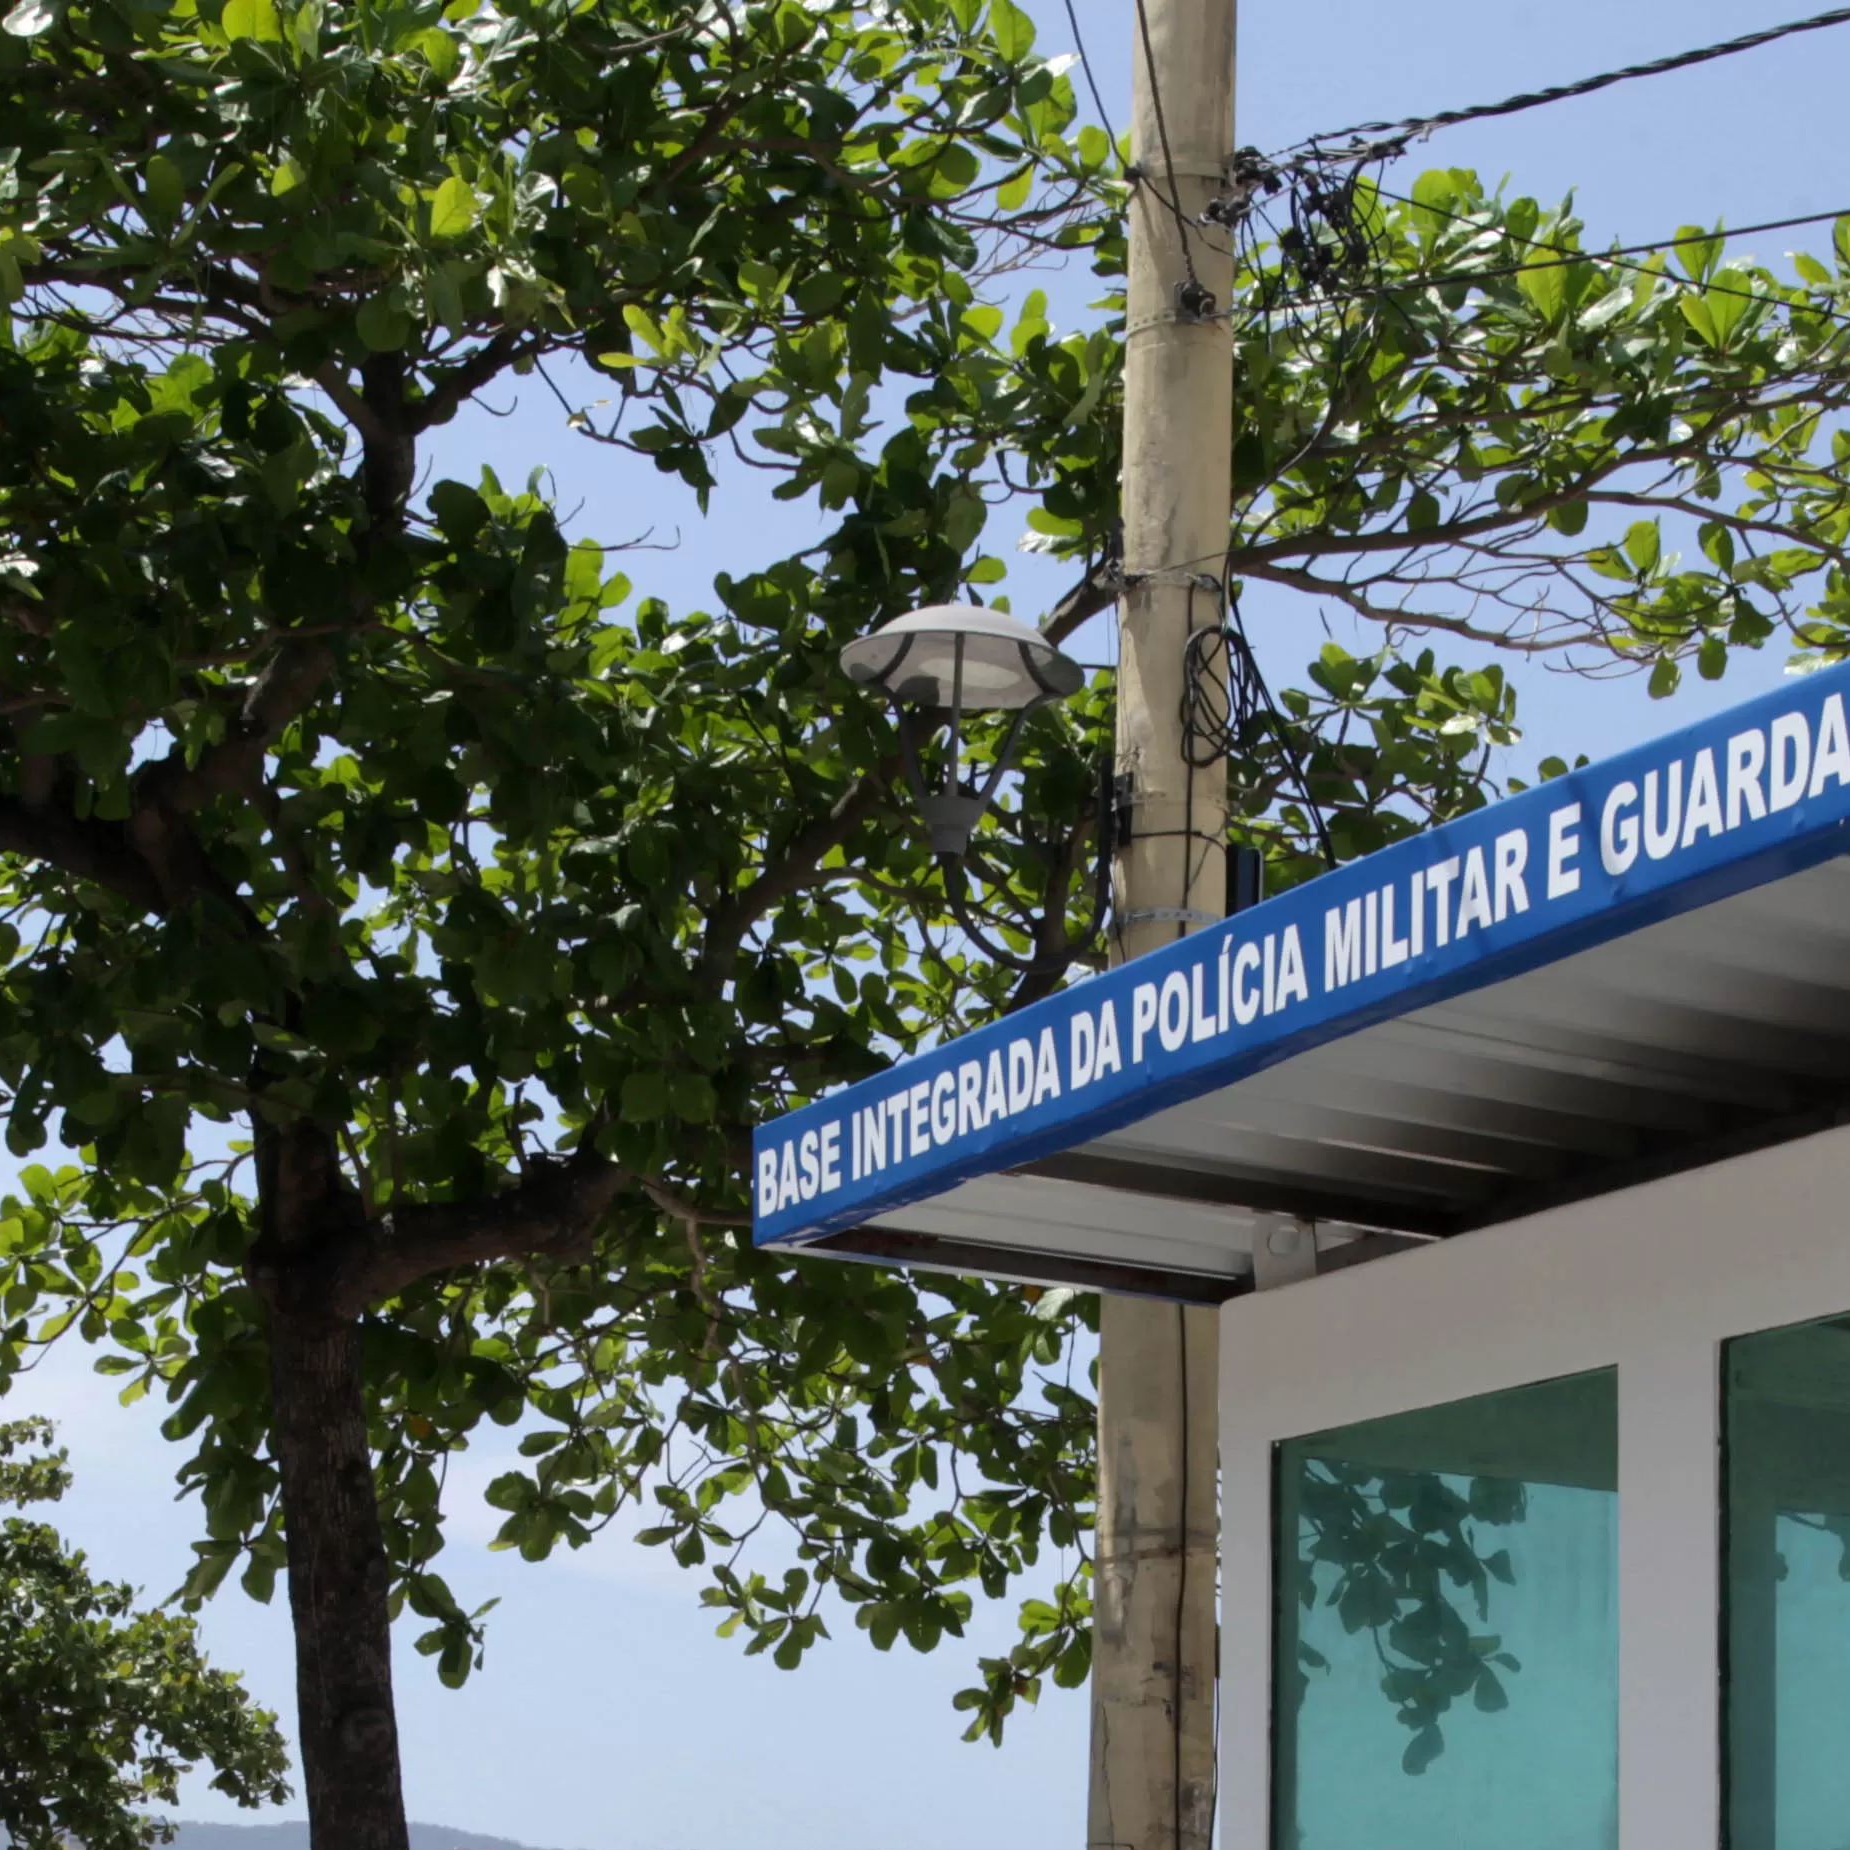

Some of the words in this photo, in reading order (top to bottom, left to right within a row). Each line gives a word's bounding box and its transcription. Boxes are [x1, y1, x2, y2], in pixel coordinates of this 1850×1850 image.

[758, 1119, 842, 1219] BASE
[851, 1026, 1062, 1182] INTEGRADA
[1071, 1000, 1122, 1091] DA
[1132, 924, 1309, 1065] POLÍCIA
[1325, 828, 1531, 993] MILITAR
[1546, 802, 1582, 900] E
